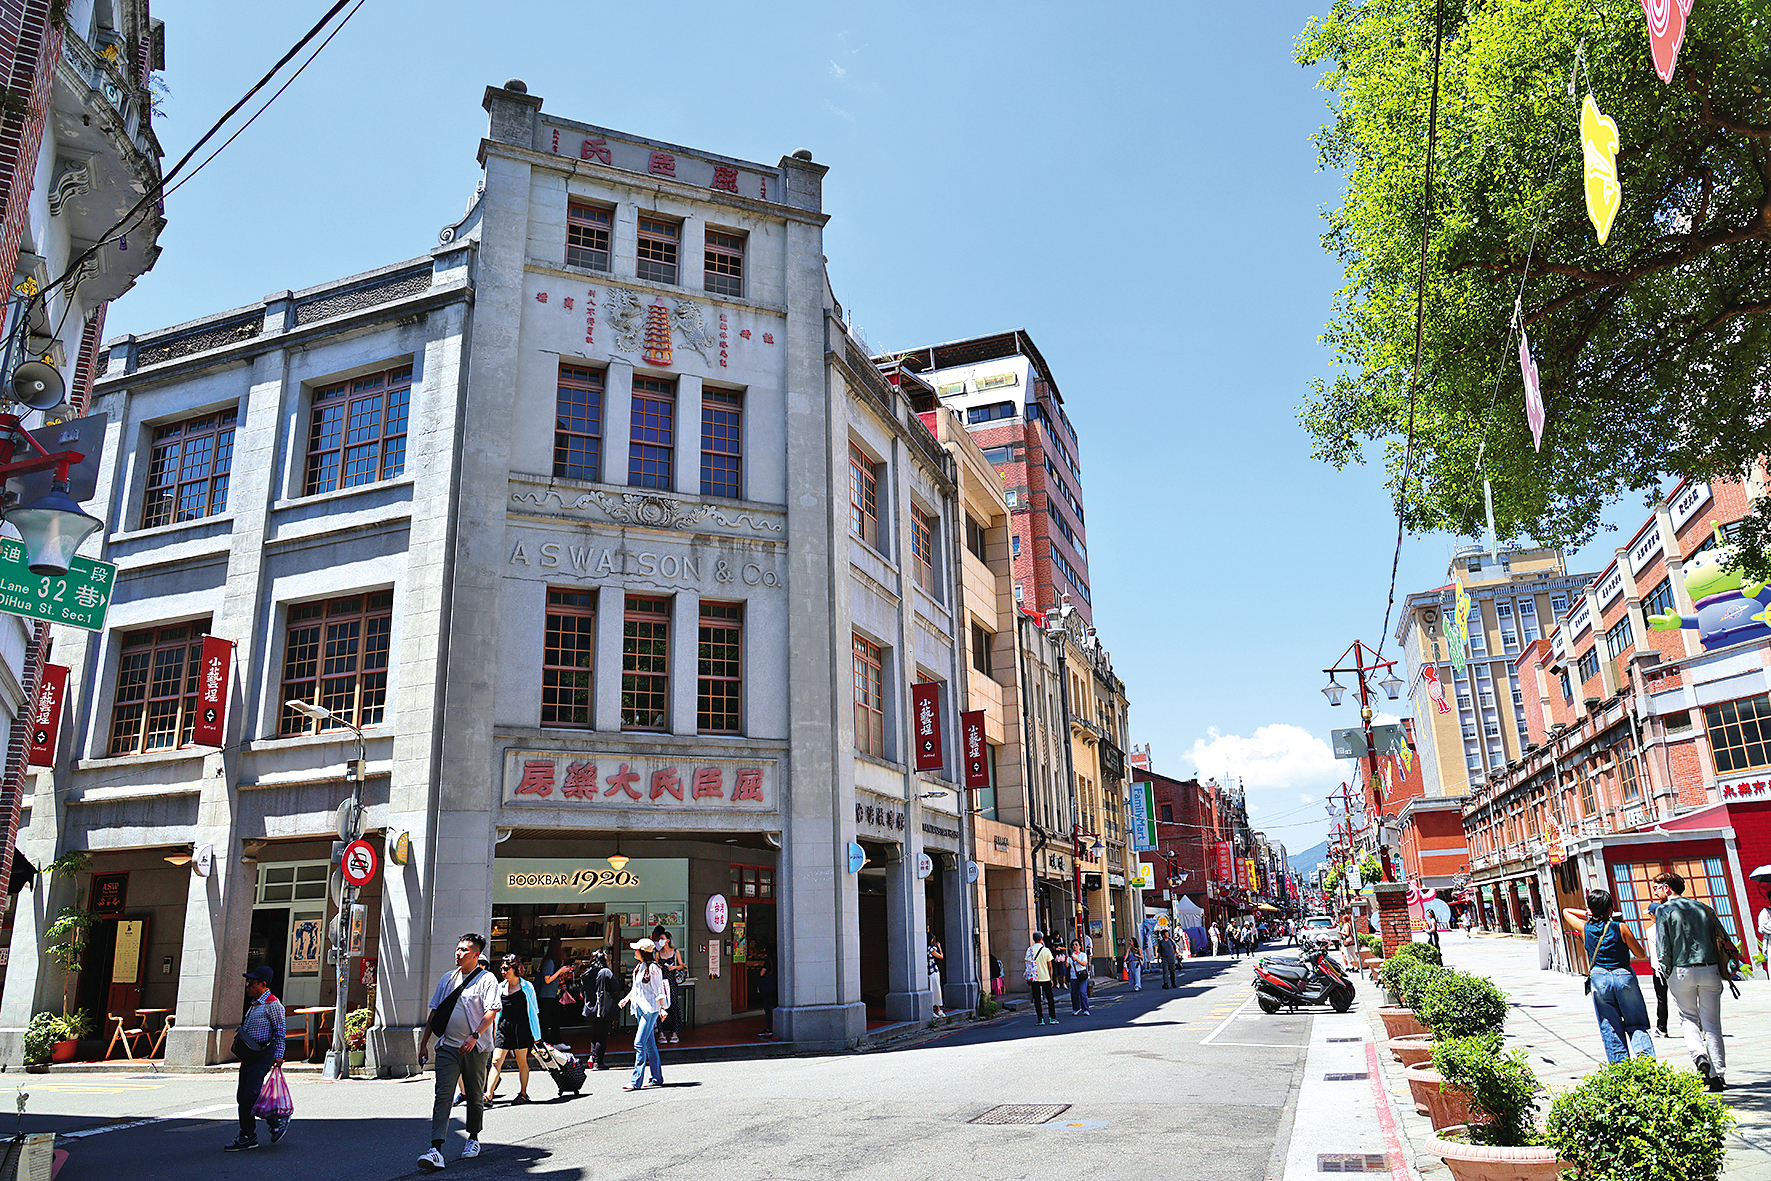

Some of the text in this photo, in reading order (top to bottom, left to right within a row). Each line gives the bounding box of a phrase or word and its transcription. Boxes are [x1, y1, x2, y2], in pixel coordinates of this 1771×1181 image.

[0, 578, 30, 594] Lane
[714, 560, 735, 584] &
[741, 562, 783, 588] Co.
[38, 602, 55, 616] St.
[204, 656, 224, 703] 小藝埕
[35, 681, 56, 725] 小藝埕
[919, 698, 935, 736] 小藝埕
[967, 724, 982, 758] 小藝埕
[514, 760, 766, 802] 屈臣氏大藥房
[1722, 779, 1771, 800] 永樂市
[1133, 787, 1147, 842] FamilyMart
[507, 869, 641, 895] BOOKBAR 1920s
